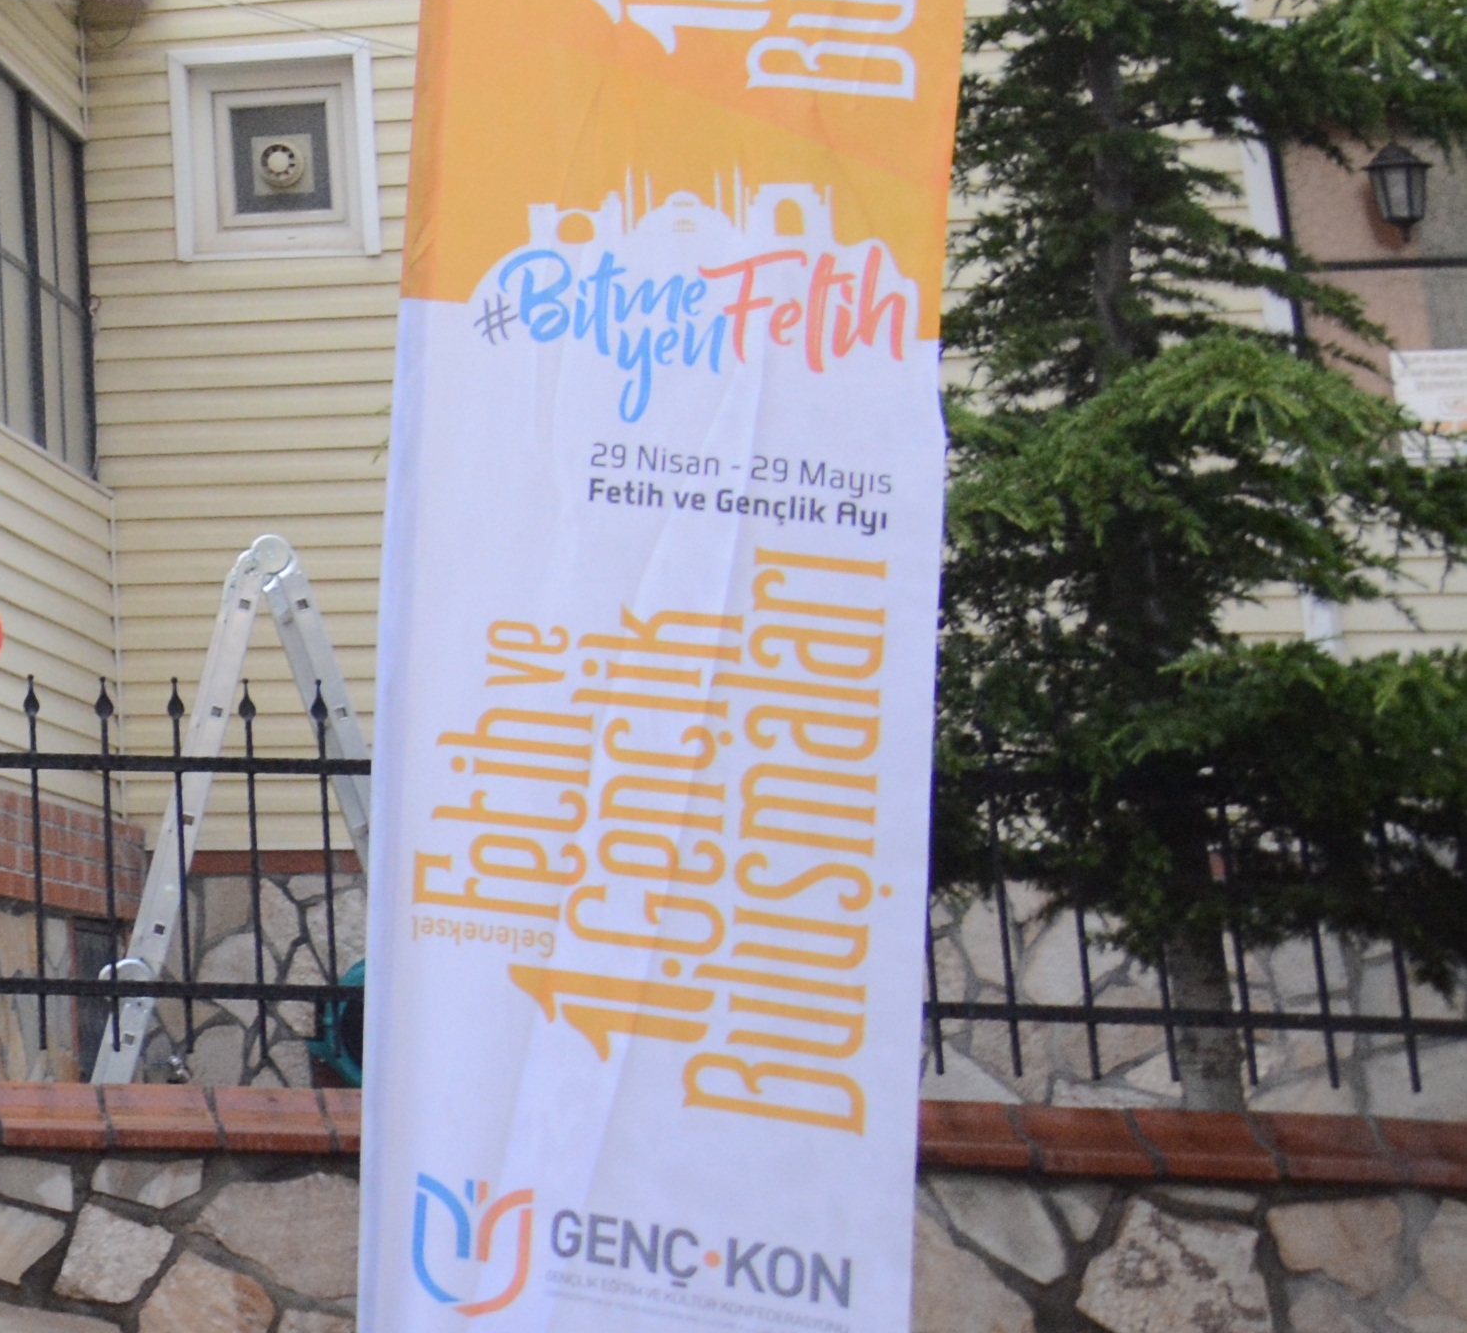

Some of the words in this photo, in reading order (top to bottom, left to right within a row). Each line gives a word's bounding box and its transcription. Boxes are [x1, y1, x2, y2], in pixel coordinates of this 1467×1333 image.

[698, 244, 906, 373] Fetih
[590, 442, 626, 469] 29
[637, 444, 720, 476] Nisan
[750, 455, 788, 484] 29
[800, 460, 892, 499] Mayıs
[588, 478, 663, 508] Fetih
[674, 489, 706, 511] ve
[715, 488, 826, 526] Gençlik
[836, 501, 888, 536] Ayı
[484, 620, 568, 687] ve
[413, 708, 593, 921] Fetih
[680, 547, 893, 1137] Buluşmaları
[411, 915, 556, 958] Geleneksel
